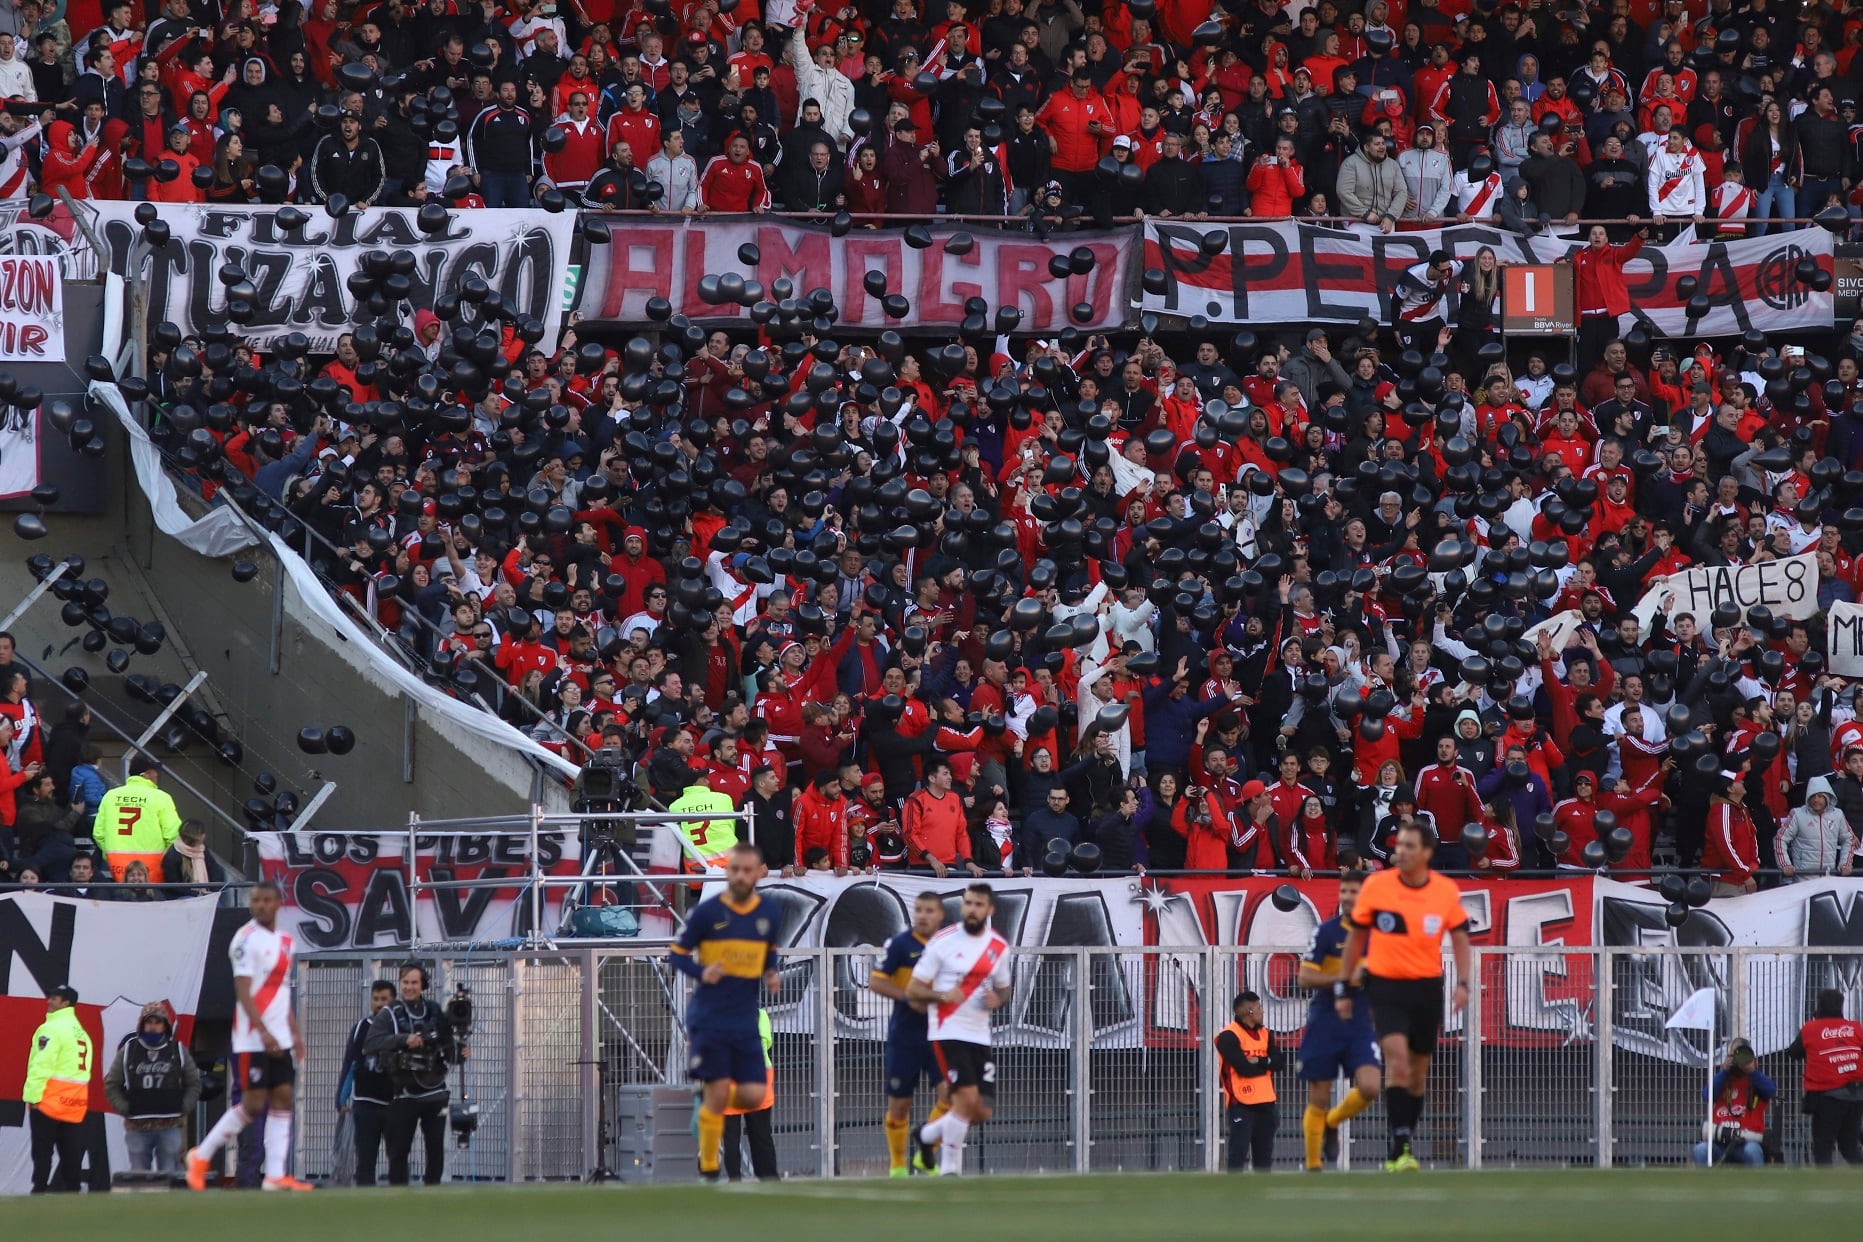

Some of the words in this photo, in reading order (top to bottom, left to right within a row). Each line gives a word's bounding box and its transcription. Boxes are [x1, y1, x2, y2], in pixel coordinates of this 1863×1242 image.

[0, 259, 53, 316] ZON
[105, 218, 556, 338] ITUZANGO
[604, 226, 1118, 331] ALMAGRO
[0, 322, 49, 356] IR
[1534, 321, 1555, 329] BBVA
[1555, 321, 1572, 329] River
[1687, 562, 1782, 611] HACE
[1784, 560, 1808, 603] 8
[681, 803, 713, 813] TECH
[281, 833, 380, 867] LOS
[402, 833, 567, 866] PIBES
[142, 1075, 165, 1090] 07
